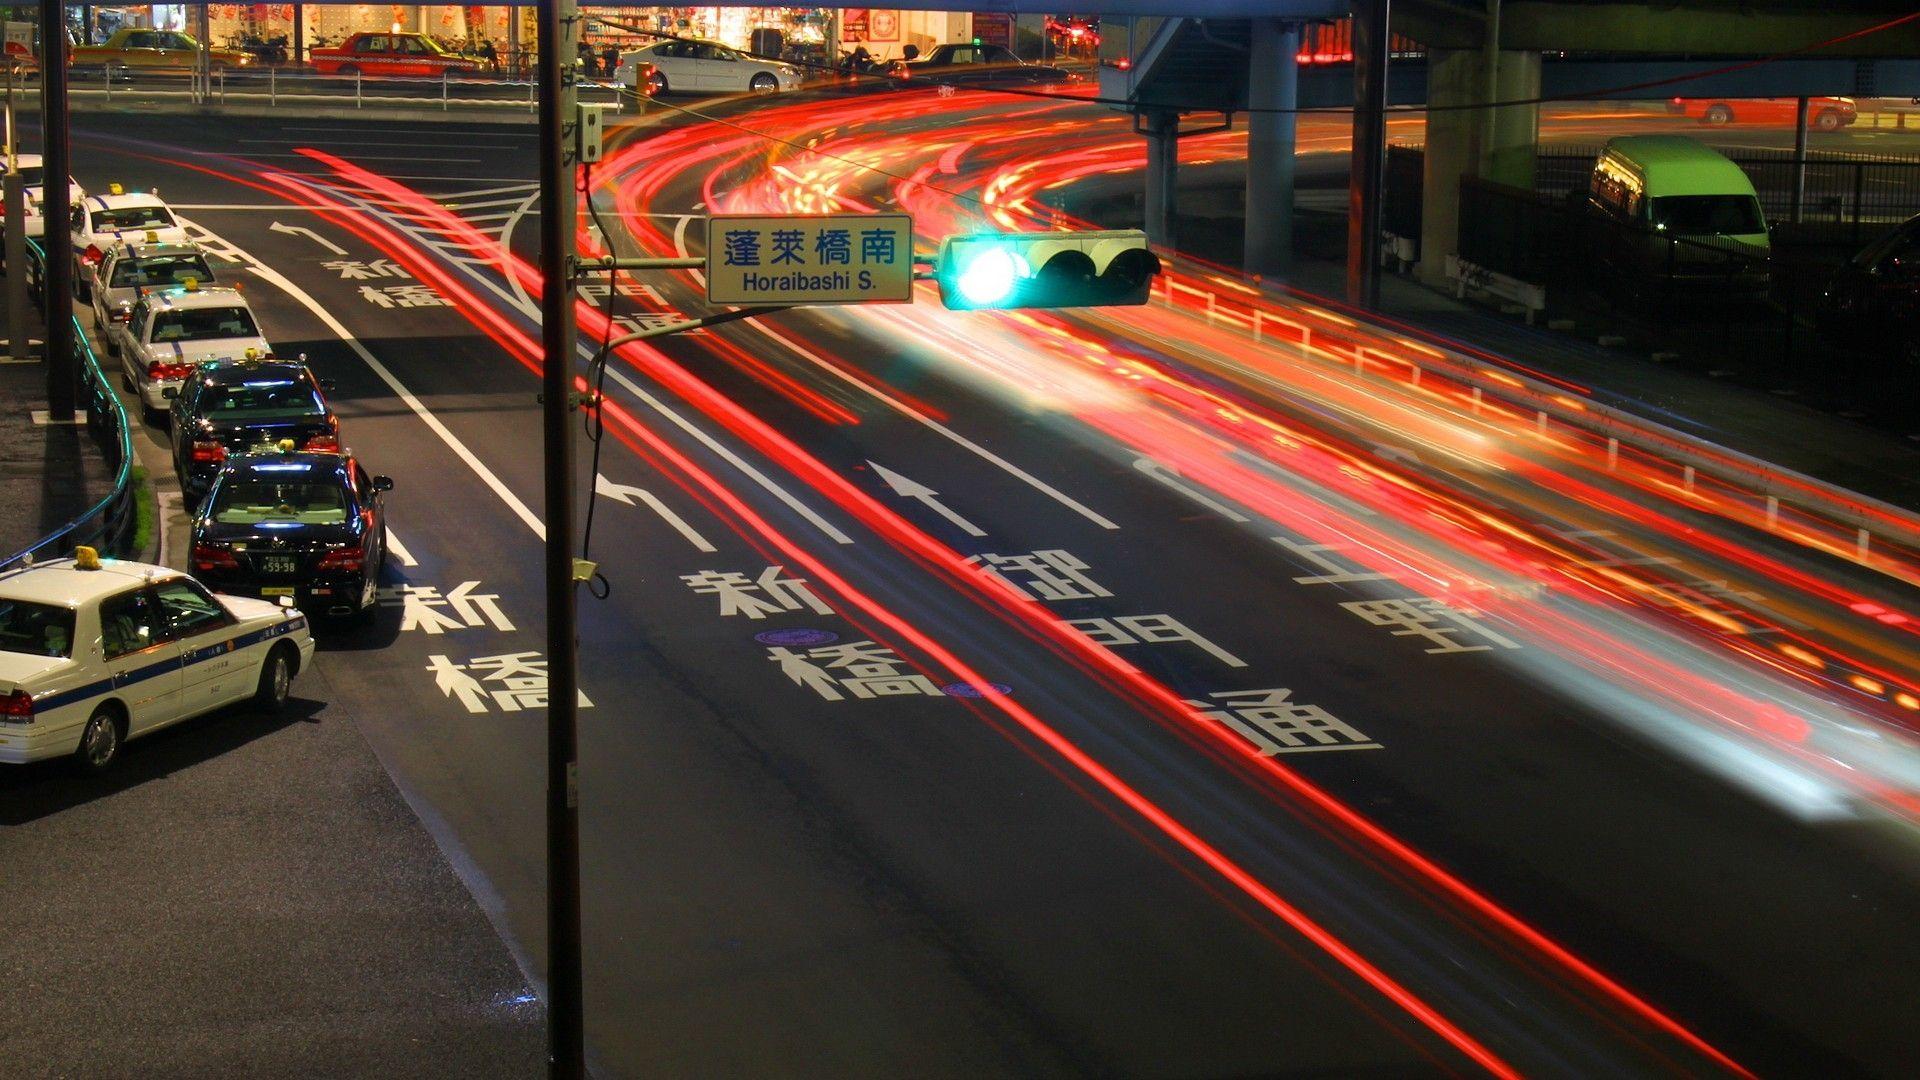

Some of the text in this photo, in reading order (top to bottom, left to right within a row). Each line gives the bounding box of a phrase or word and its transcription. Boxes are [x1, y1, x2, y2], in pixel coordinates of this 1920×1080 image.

[320, 259, 460, 308] 新橋
[724, 228, 897, 266] 蓬萊橋南
[743, 270, 877, 291] Horaibashi S.
[679, 565, 948, 701] 新橋
[1270, 536, 1522, 655] 上野
[376, 580, 595, 714] 新橋
